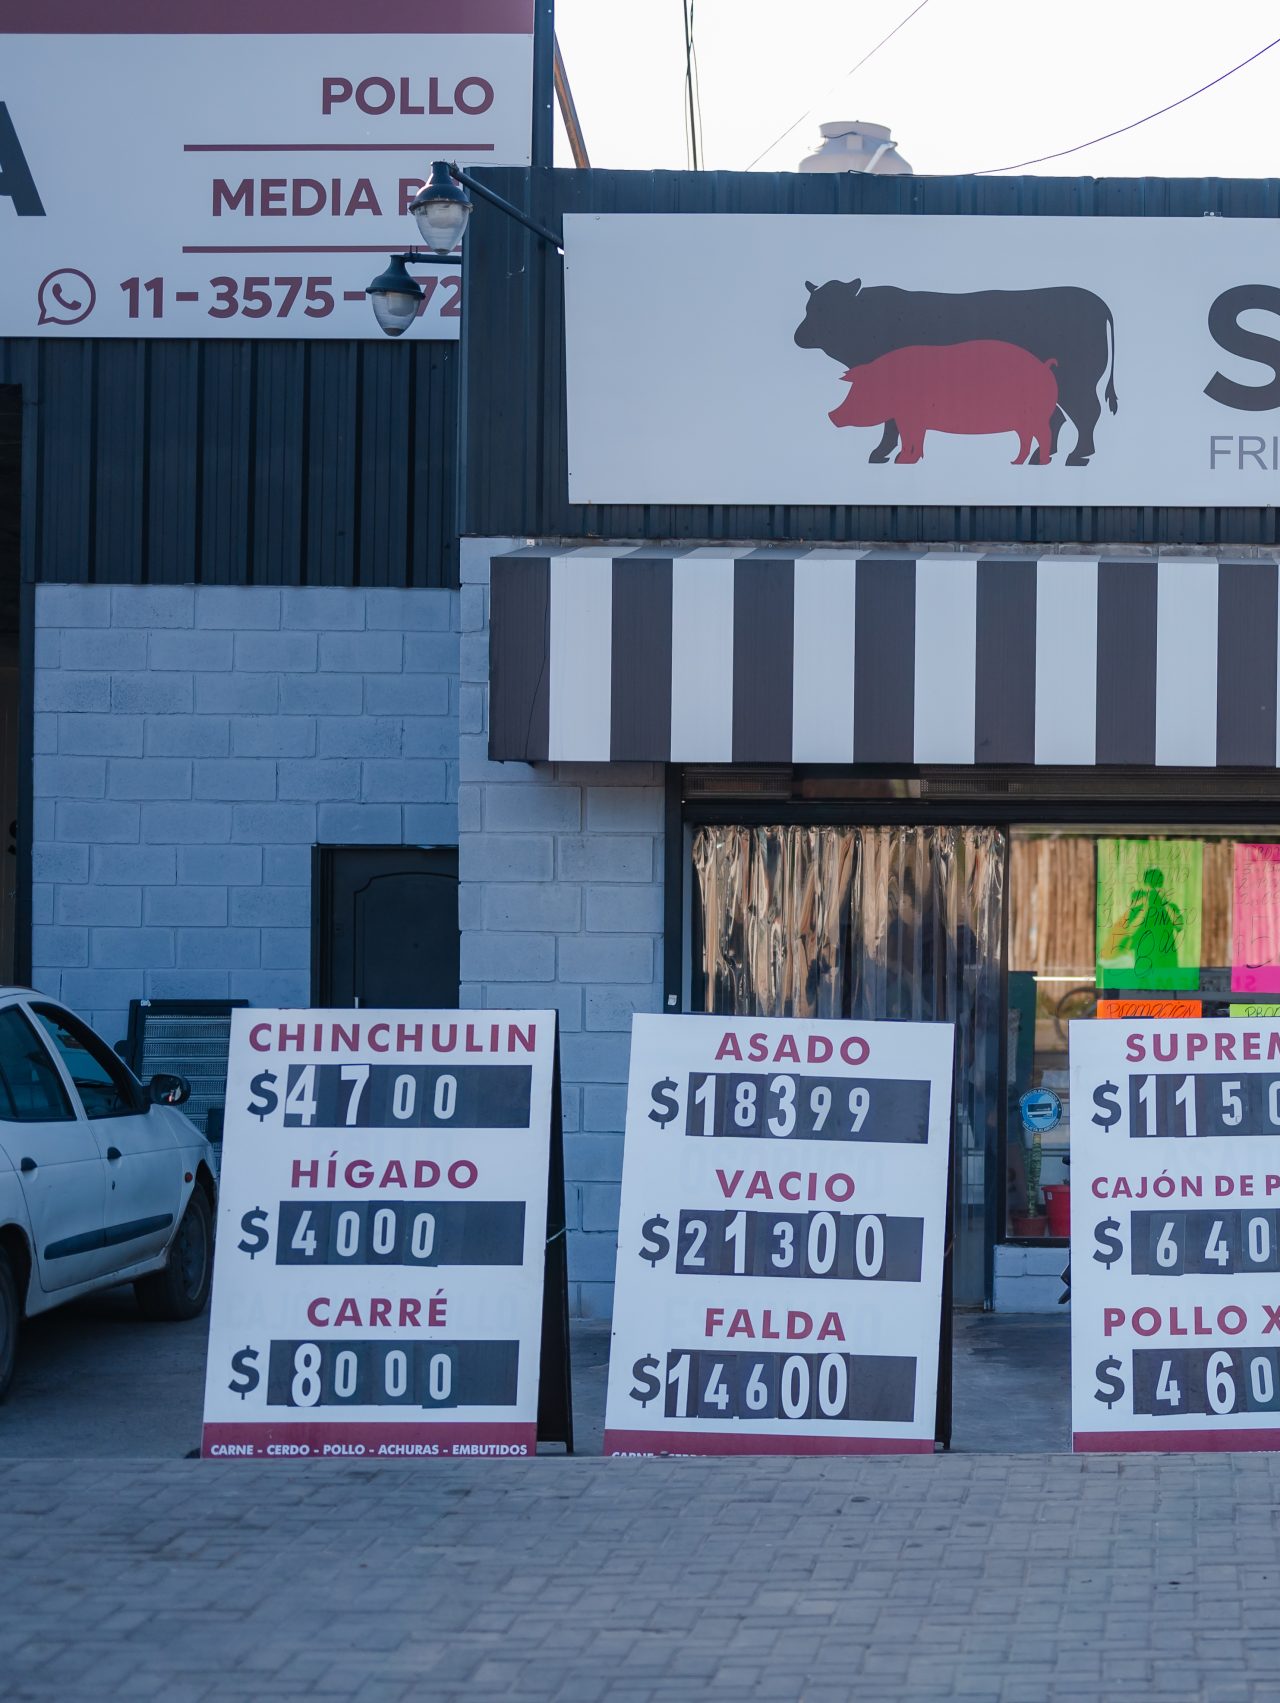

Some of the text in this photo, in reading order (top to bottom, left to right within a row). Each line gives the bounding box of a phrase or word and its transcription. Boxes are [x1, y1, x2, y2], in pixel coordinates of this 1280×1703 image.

[322, 76, 494, 116] POLLO
[212, 178, 382, 217] MEDIA
[249, 1022, 537, 1053] CHINCHULIN
[714, 1032, 870, 1066] ASADO
[290, 1150, 478, 1189] HÍGADO
[715, 1169, 855, 1203] VACIO
[1091, 1169, 1203, 1199] CAJÓN
[1215, 1175, 1254, 1197] DE
[307, 1288, 448, 1328] CARRÉ
[704, 1307, 846, 1341] FALDA
[1103, 1304, 1248, 1337] POLLO
[211, 1444, 254, 1456] CARNE
[267, 1444, 310, 1456] CERDO
[323, 1444, 365, 1456] POLLO
[378, 1444, 439, 1455] ACHURAS
[452, 1444, 528, 1455] EMBUTIDOS
